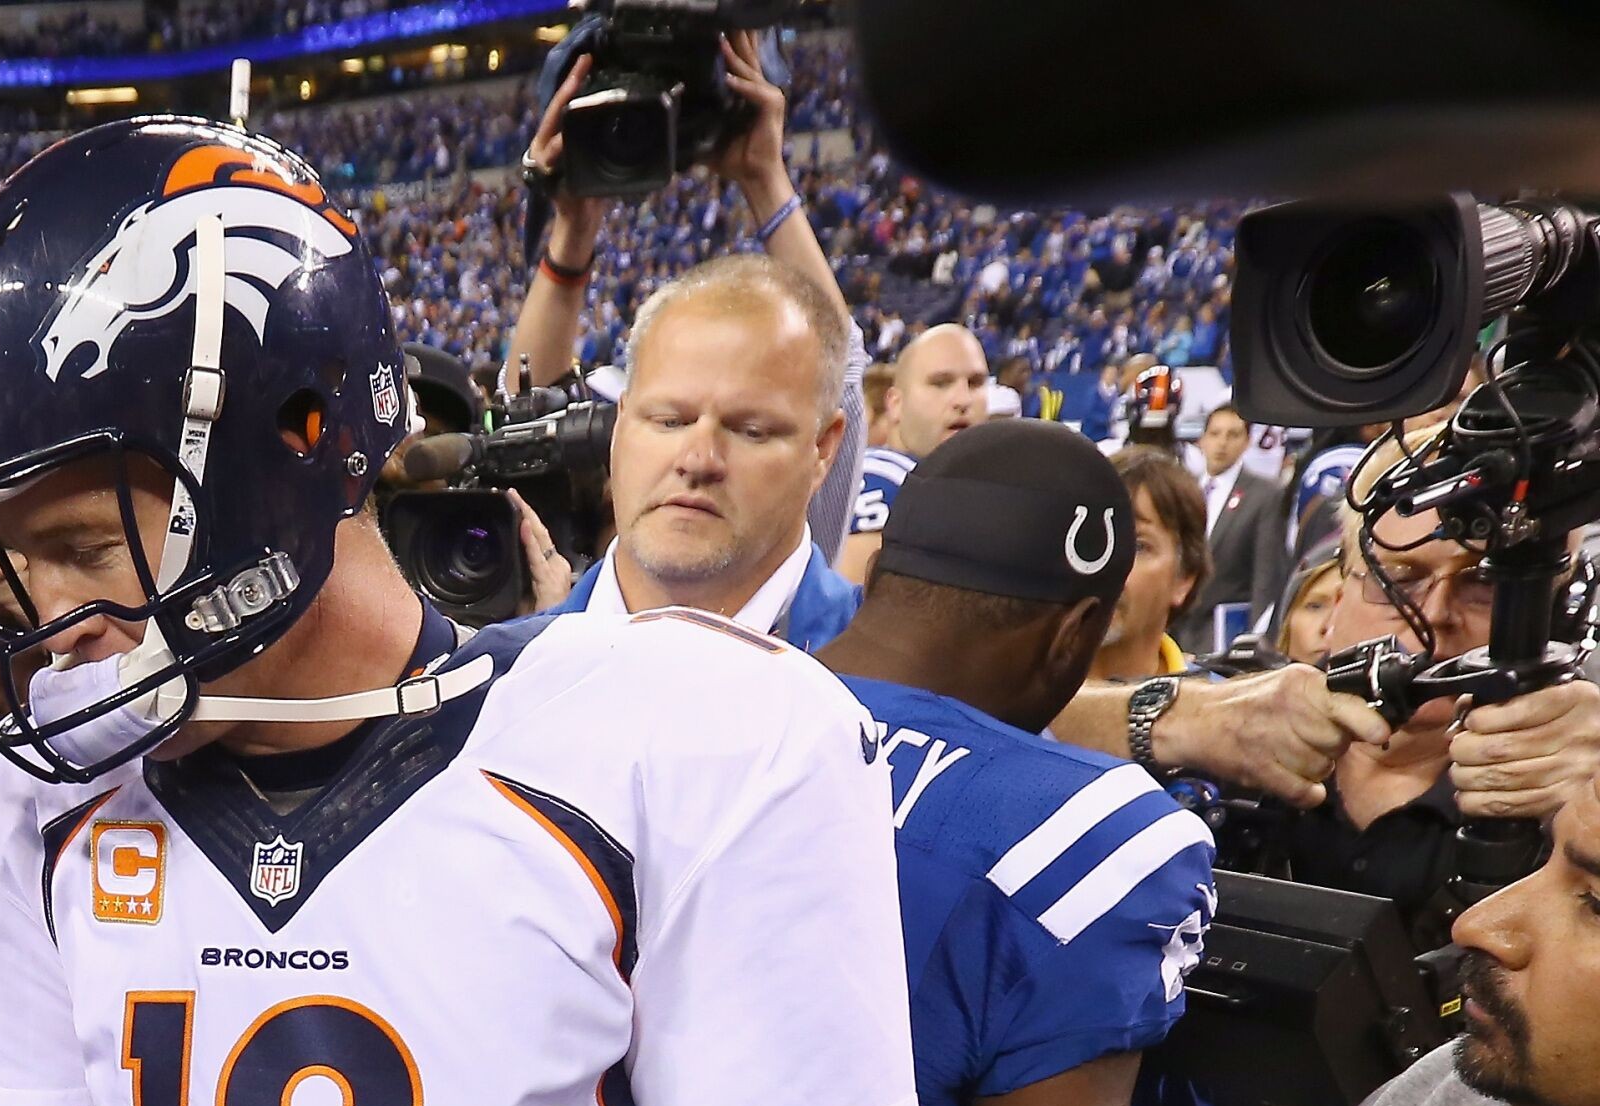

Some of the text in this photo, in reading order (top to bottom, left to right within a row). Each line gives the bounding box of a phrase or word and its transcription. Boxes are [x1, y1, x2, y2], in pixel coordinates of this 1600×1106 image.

[97, 828, 159, 896] C
[258, 865, 293, 893] NFL
[201, 947, 349, 971] BRONCOS
